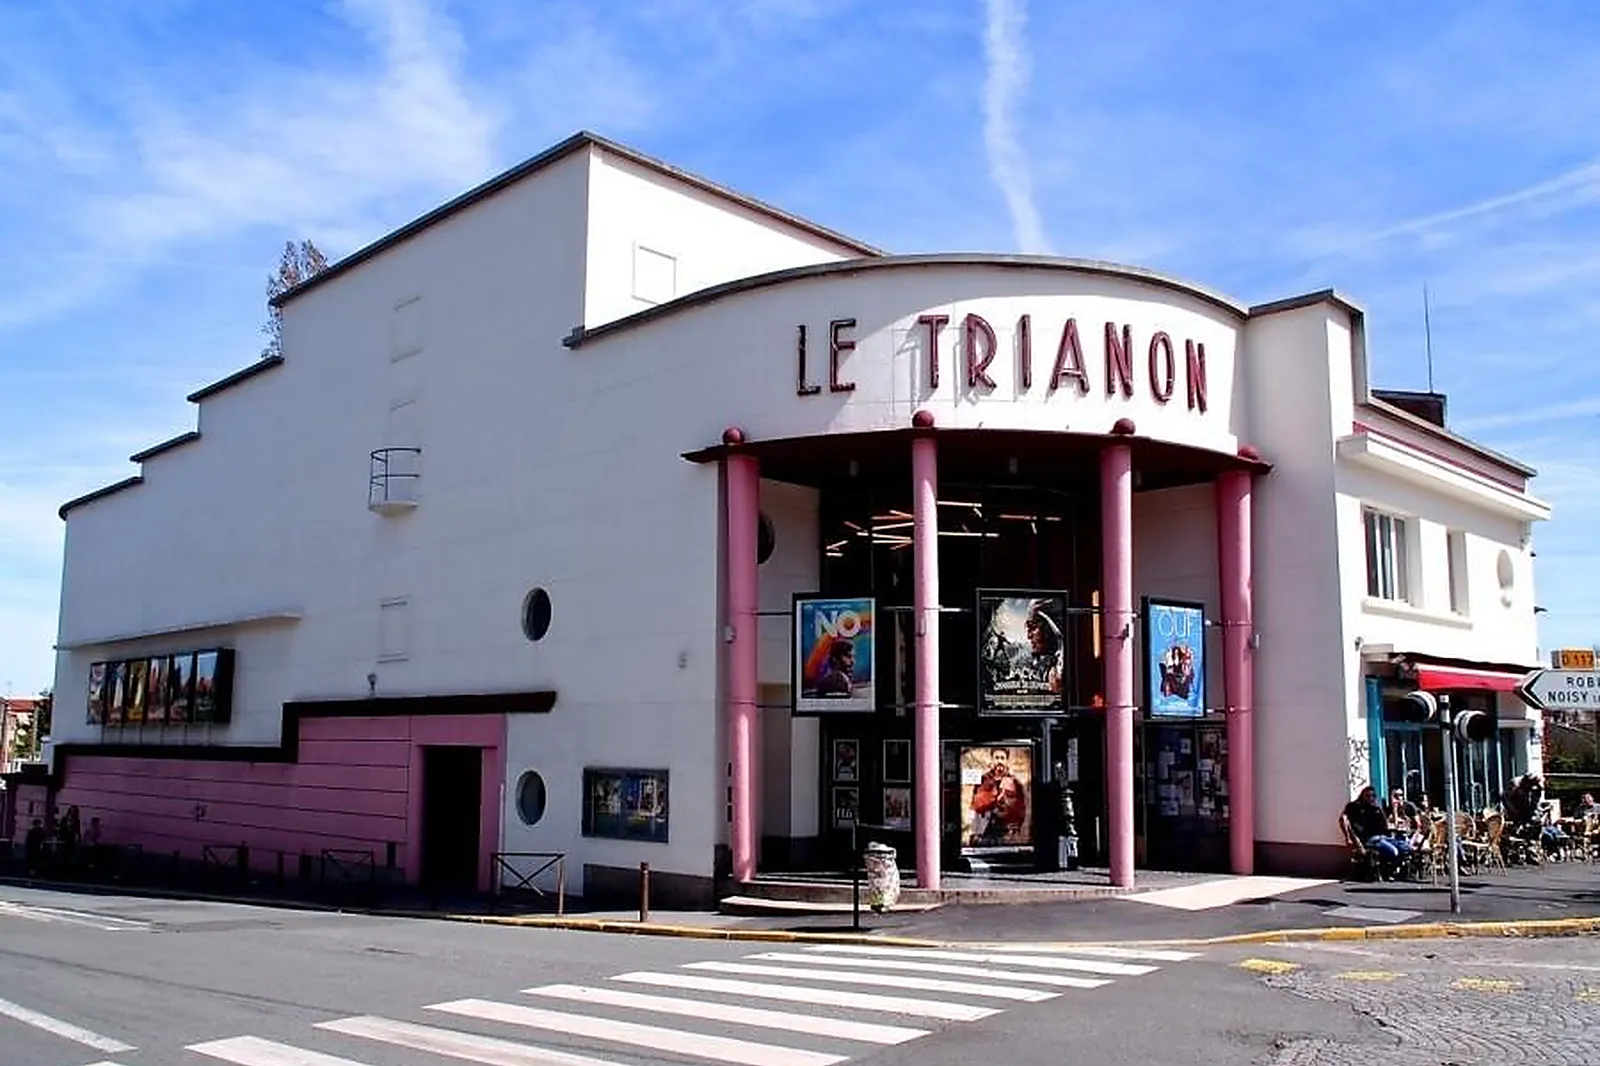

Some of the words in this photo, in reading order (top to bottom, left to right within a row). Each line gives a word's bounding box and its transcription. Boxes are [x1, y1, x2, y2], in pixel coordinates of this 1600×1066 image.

[796, 318, 856, 396] LE
[917, 312, 1209, 413] TRIANON
[815, 609, 861, 638] NO
[1547, 691, 1588, 703] NOISY
